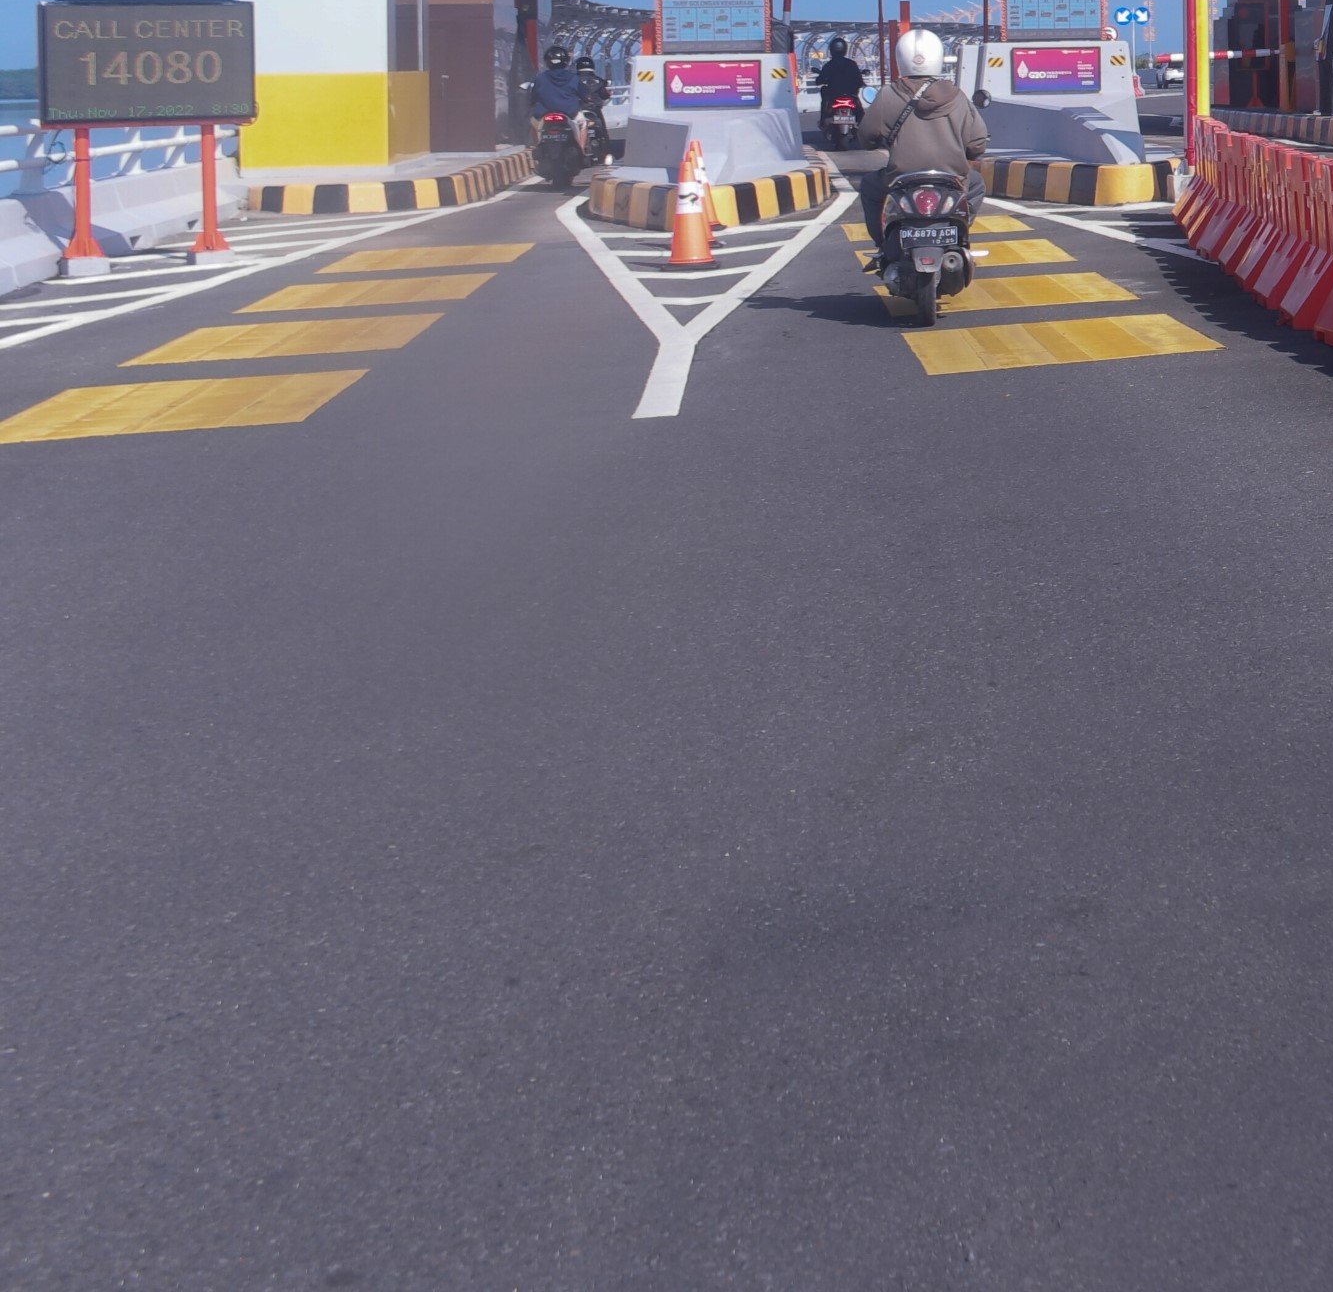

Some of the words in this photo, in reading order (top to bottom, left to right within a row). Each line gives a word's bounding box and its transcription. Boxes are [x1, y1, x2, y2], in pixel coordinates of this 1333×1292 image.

[54, 20, 128, 39] CALL
[136, 19, 245, 39] CENTER
[79, 49, 223, 86] 14080
[1028, 71, 1047, 79] G20
[682, 86, 702, 94] G20
